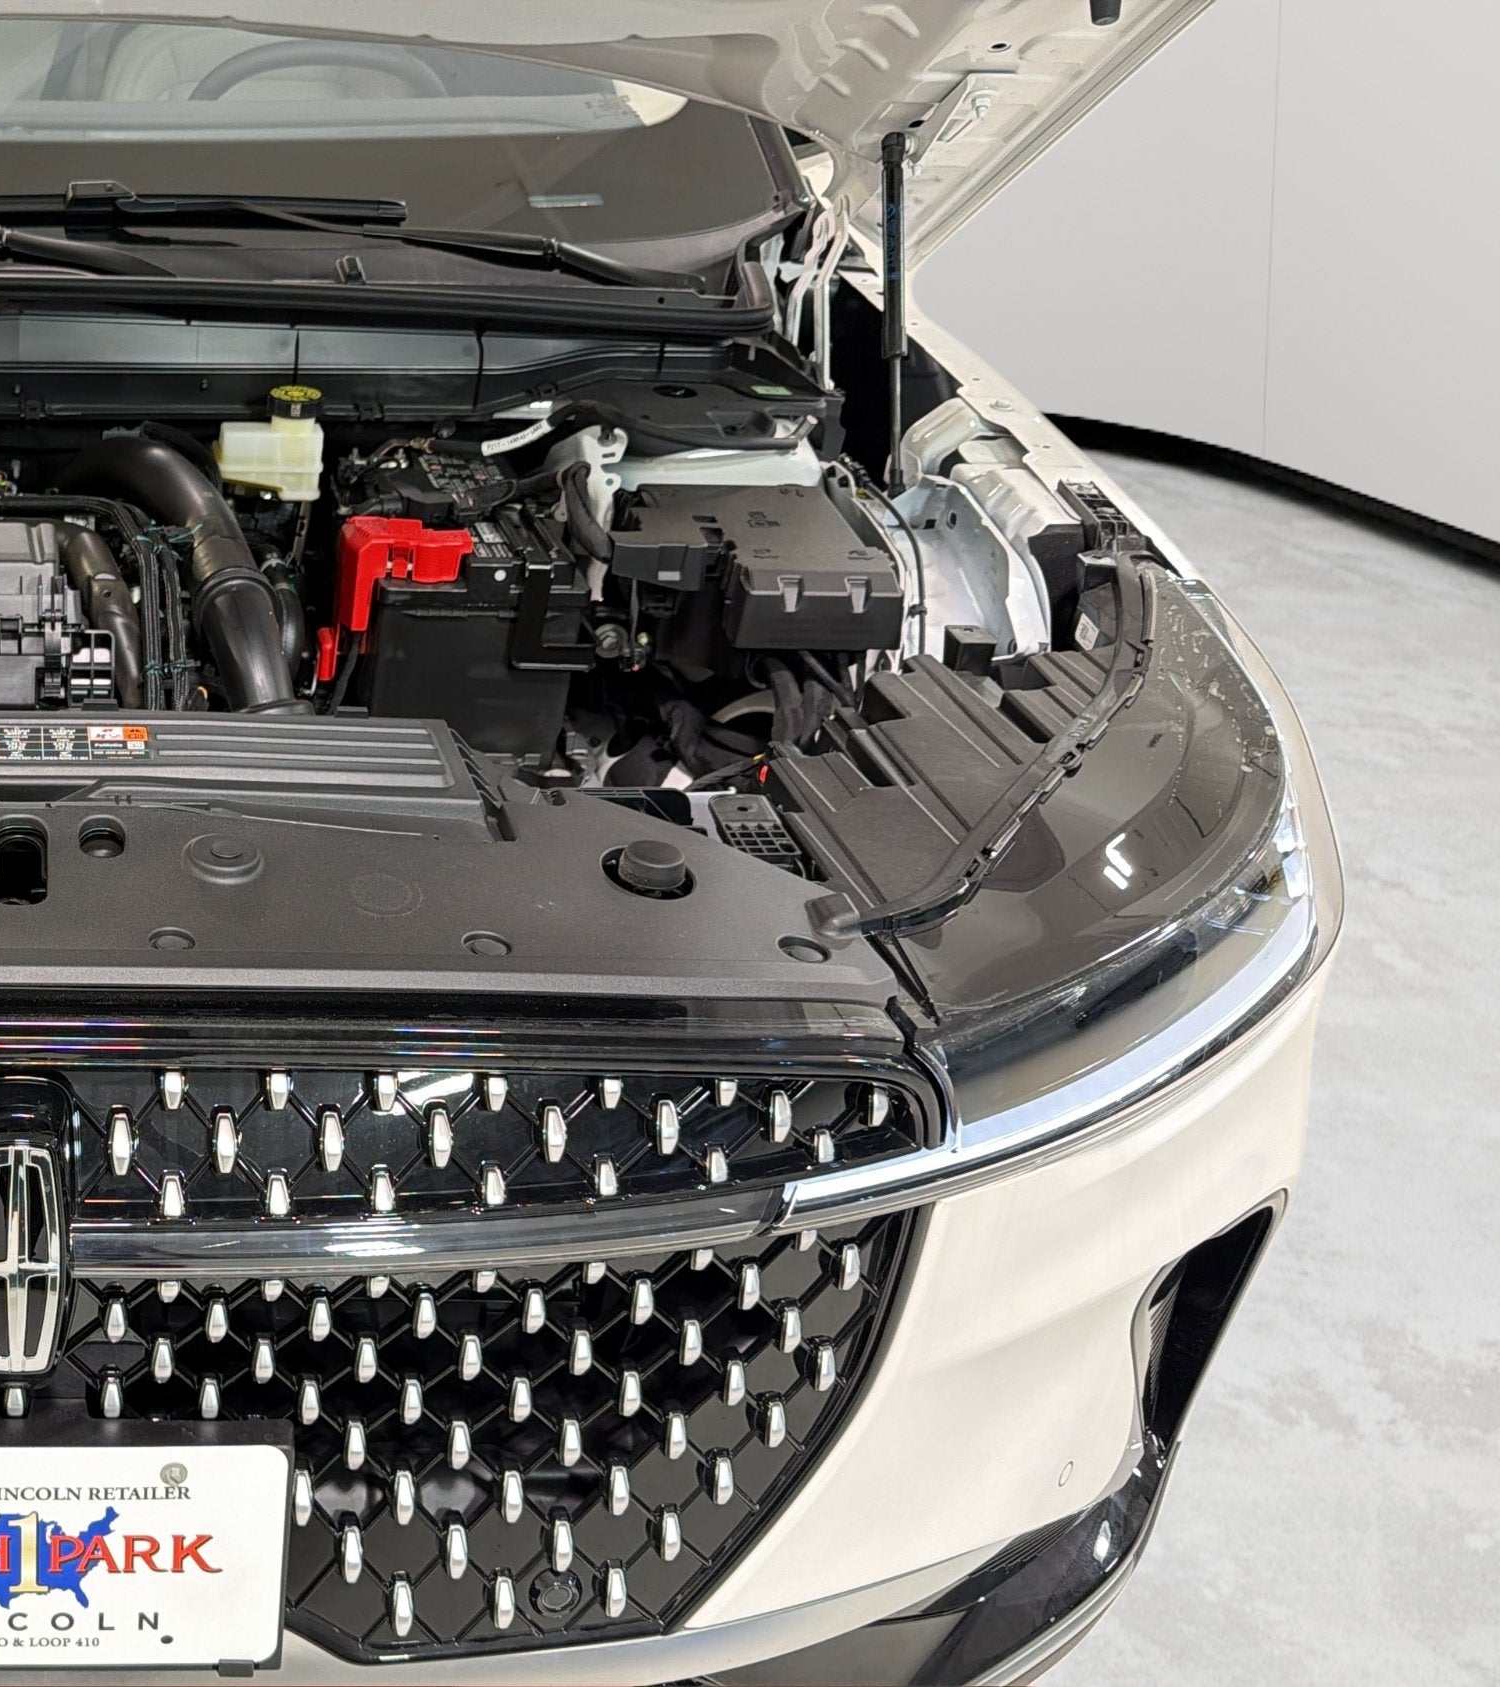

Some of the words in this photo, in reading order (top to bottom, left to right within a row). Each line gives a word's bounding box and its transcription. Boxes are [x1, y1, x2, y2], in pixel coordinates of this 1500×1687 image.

[88, 1485, 192, 1501] RETAILER
[47, 1534, 223, 1574] PARK
[12, 1637, 24, 1648] &
[29, 1637, 71, 1648] LOOP
[75, 1637, 100, 1648] 410
